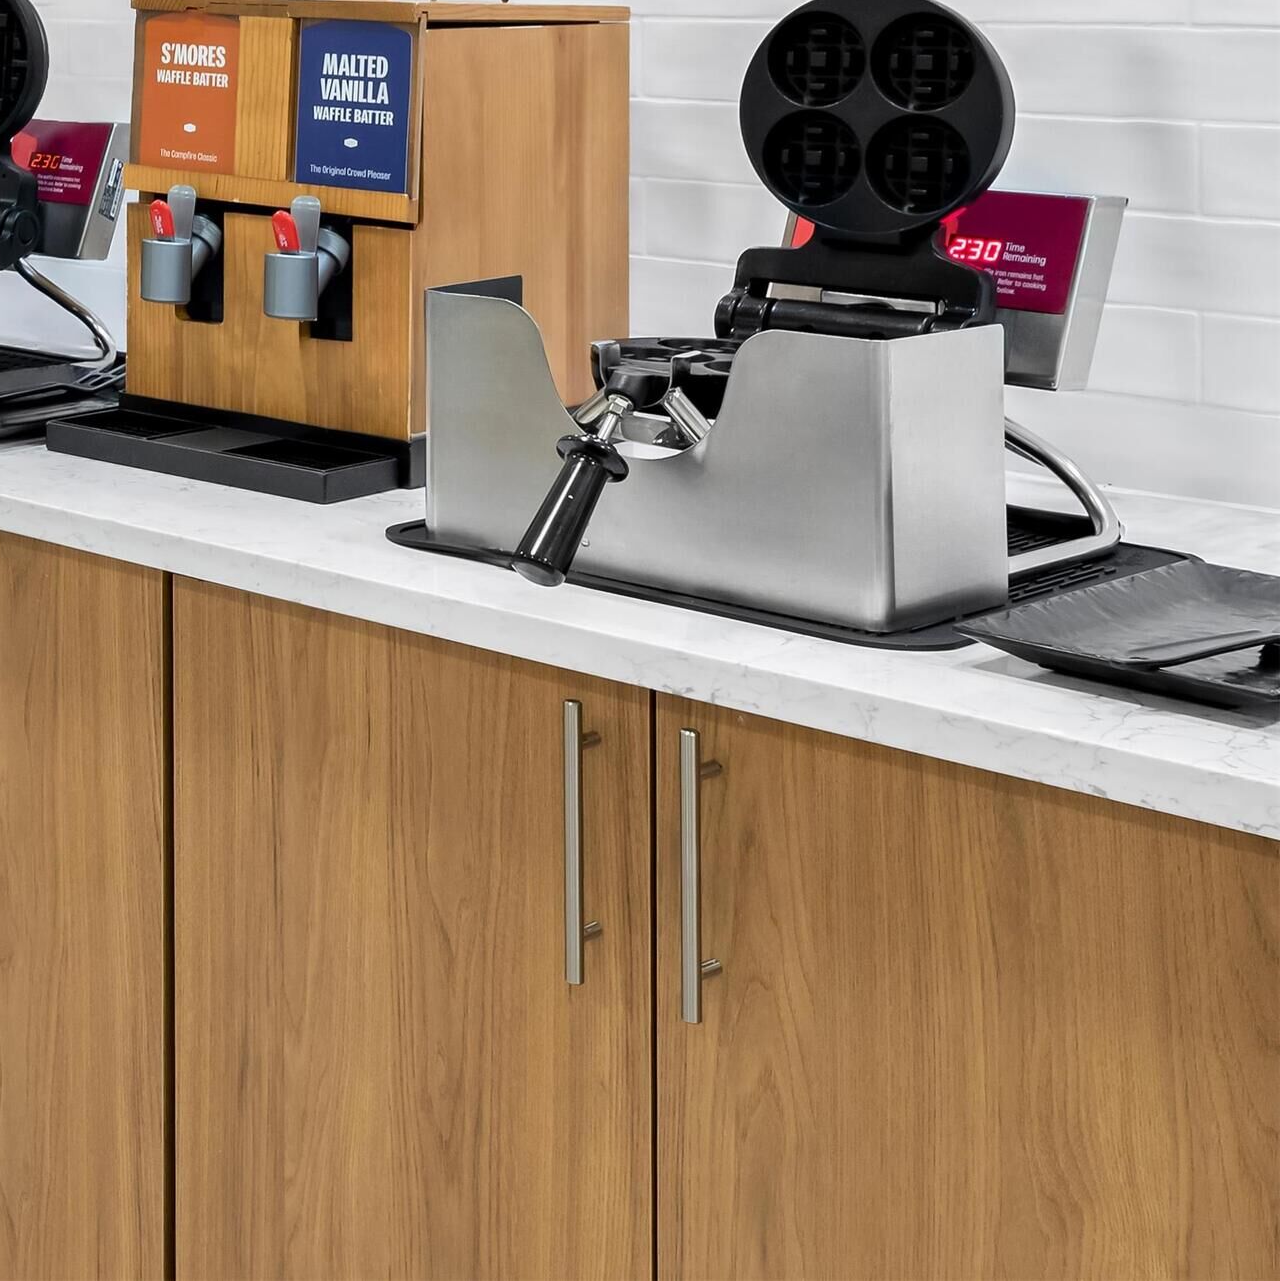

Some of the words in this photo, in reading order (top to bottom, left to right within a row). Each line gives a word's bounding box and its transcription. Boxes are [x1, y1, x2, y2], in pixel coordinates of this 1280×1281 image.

[161, 42, 226, 68] S'MORES
[321, 53, 389, 79] MALTED
[156, 69, 192, 85] WAFFLE
[192, 72, 229, 88] BATTER
[320, 78, 389, 105] VANILLA
[313, 105, 353, 123] WAFFLE
[354, 108, 394, 126] BATTER
[160, 148, 171, 158] The
[171, 149, 197, 161] Campfire
[197, 152, 218, 163] Classic
[310, 164, 321, 173] The
[322, 165, 346, 176] Original
[347, 167, 367, 178] Crowd
[367, 169, 391, 180] Pleaser
[949, 238, 1002, 261] 2:30
[1005, 242, 1026, 253] Time
[1002, 252, 1047, 267] Remaining
